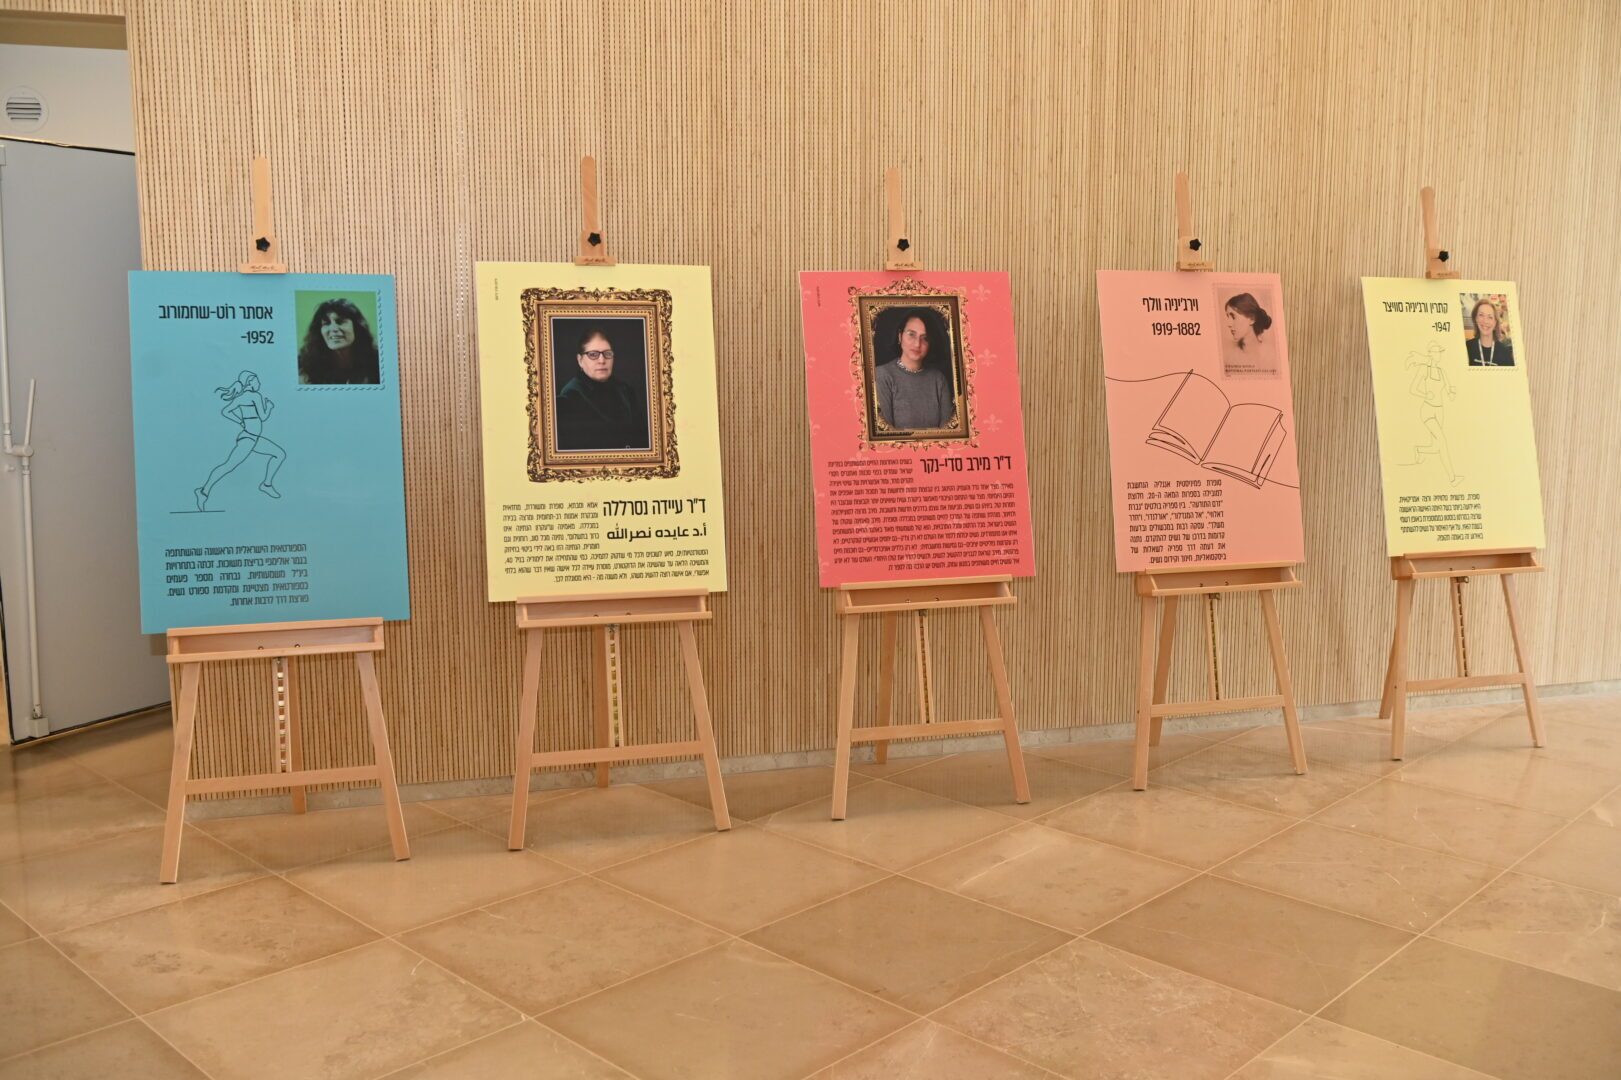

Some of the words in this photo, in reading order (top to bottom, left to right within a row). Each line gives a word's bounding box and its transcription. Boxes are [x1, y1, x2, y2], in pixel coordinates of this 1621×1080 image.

[239, 305, 273, 319] אסתר
[1142, 297, 1162, 312] וולף
[1382, 301, 1404, 312] סוויצר
[1430, 302, 1448, 314] קתרין
[920, 457, 962, 474] סדי-נקר
[966, 456, 990, 472] מירב
[603, 500, 648, 516] נסרללה
[652, 499, 682, 515] עיידה
[655, 526, 689, 540] عايده
